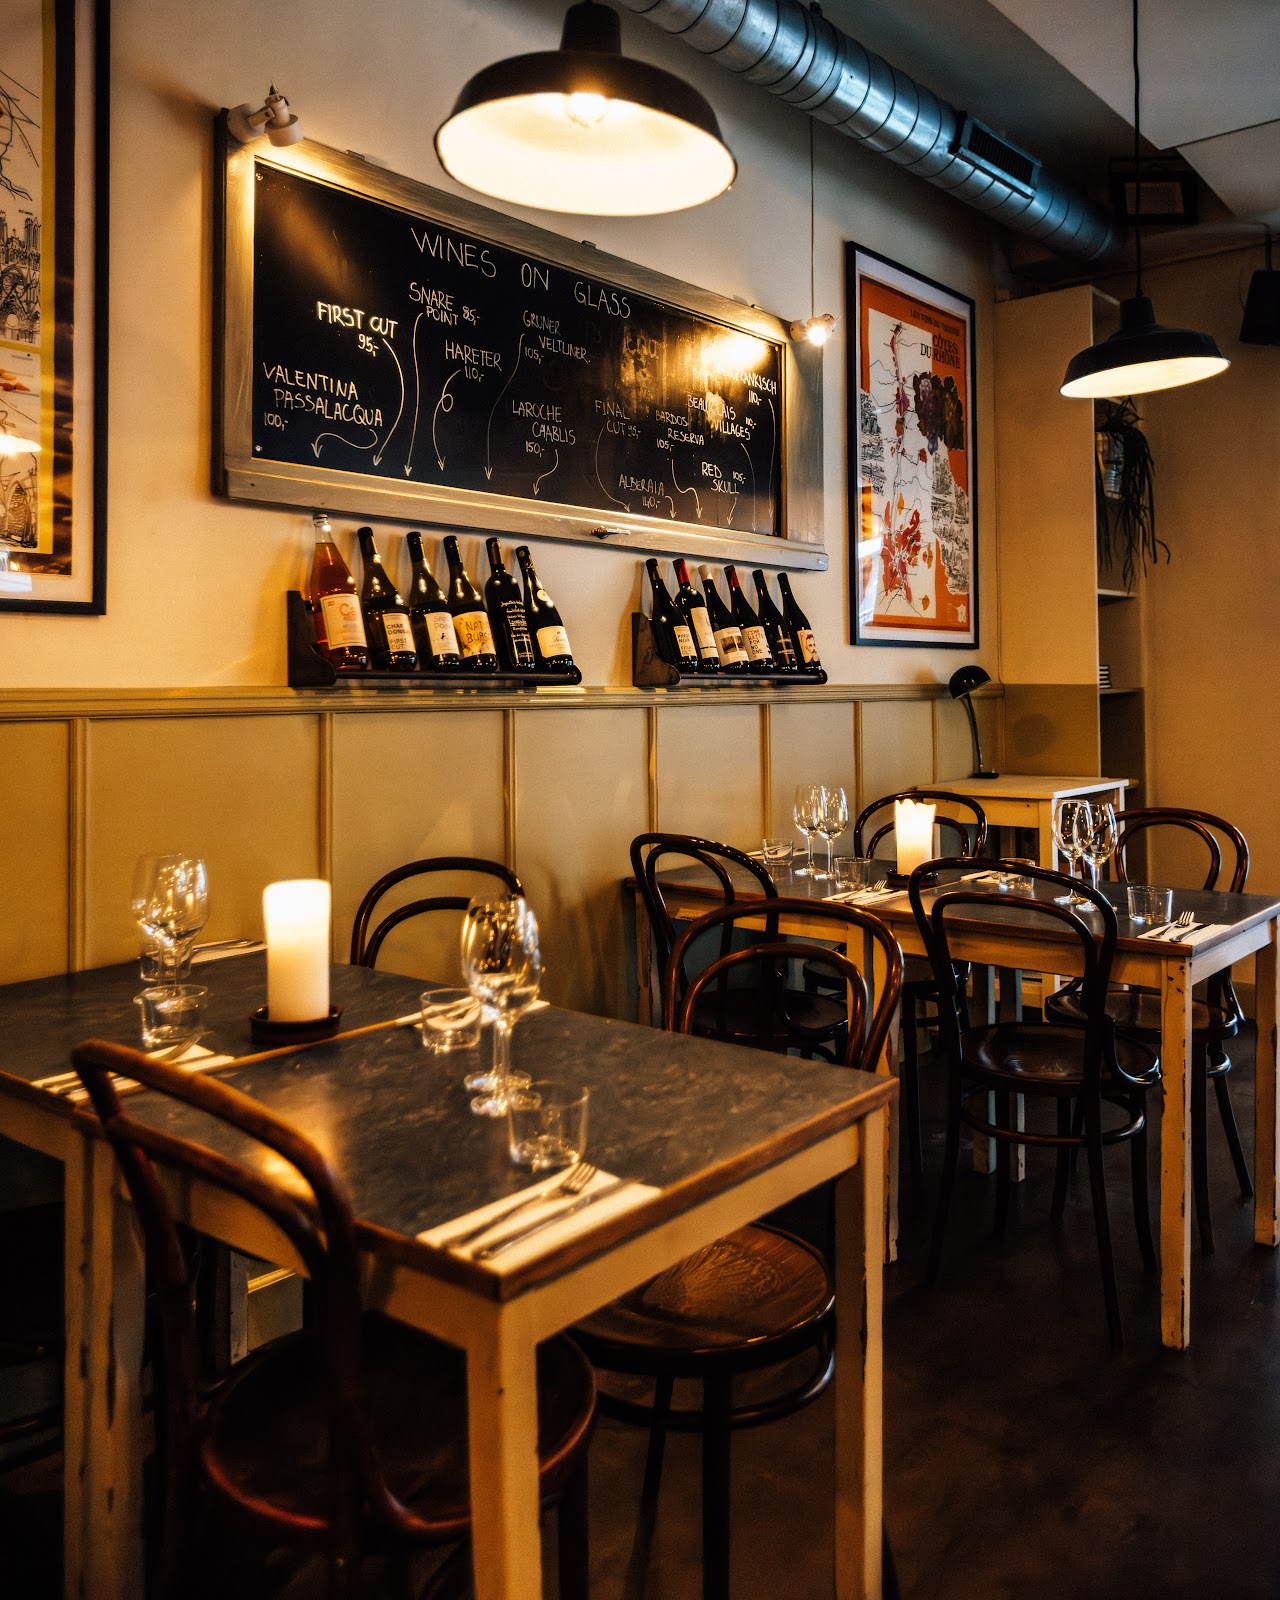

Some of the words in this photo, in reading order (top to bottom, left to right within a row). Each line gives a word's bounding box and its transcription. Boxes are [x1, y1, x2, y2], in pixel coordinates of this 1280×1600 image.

[410, 227, 497, 278] WINES
[520, 262, 549, 290] ON
[573, 281, 631, 319] GLASS
[408, 281, 454, 312] SNARE
[316, 300, 365, 329] FIRST
[369, 316, 399, 339] CUT
[425, 305, 459, 326] POINT
[357, 333, 379, 358] 95,-
[445, 339, 503, 372] HARETER
[920, 343, 932, 359] DU
[262, 361, 359, 401] VALENTINA
[273, 388, 383, 428] PASSALACQUA
[512, 399, 562, 423] LAROCHE
[594, 399, 631, 420] FINAL
[655, 410, 688, 427] BARDOS
[531, 421, 576, 446] CHABLIS
[606, 419, 626, 436] CUT
[667, 427, 705, 446] RESERVA
[712, 418, 751, 441] VILLAGES
[701, 461, 722, 479] RED
[618, 473, 665, 497] ALBERAIA
[710, 478, 740, 494] SKULL
